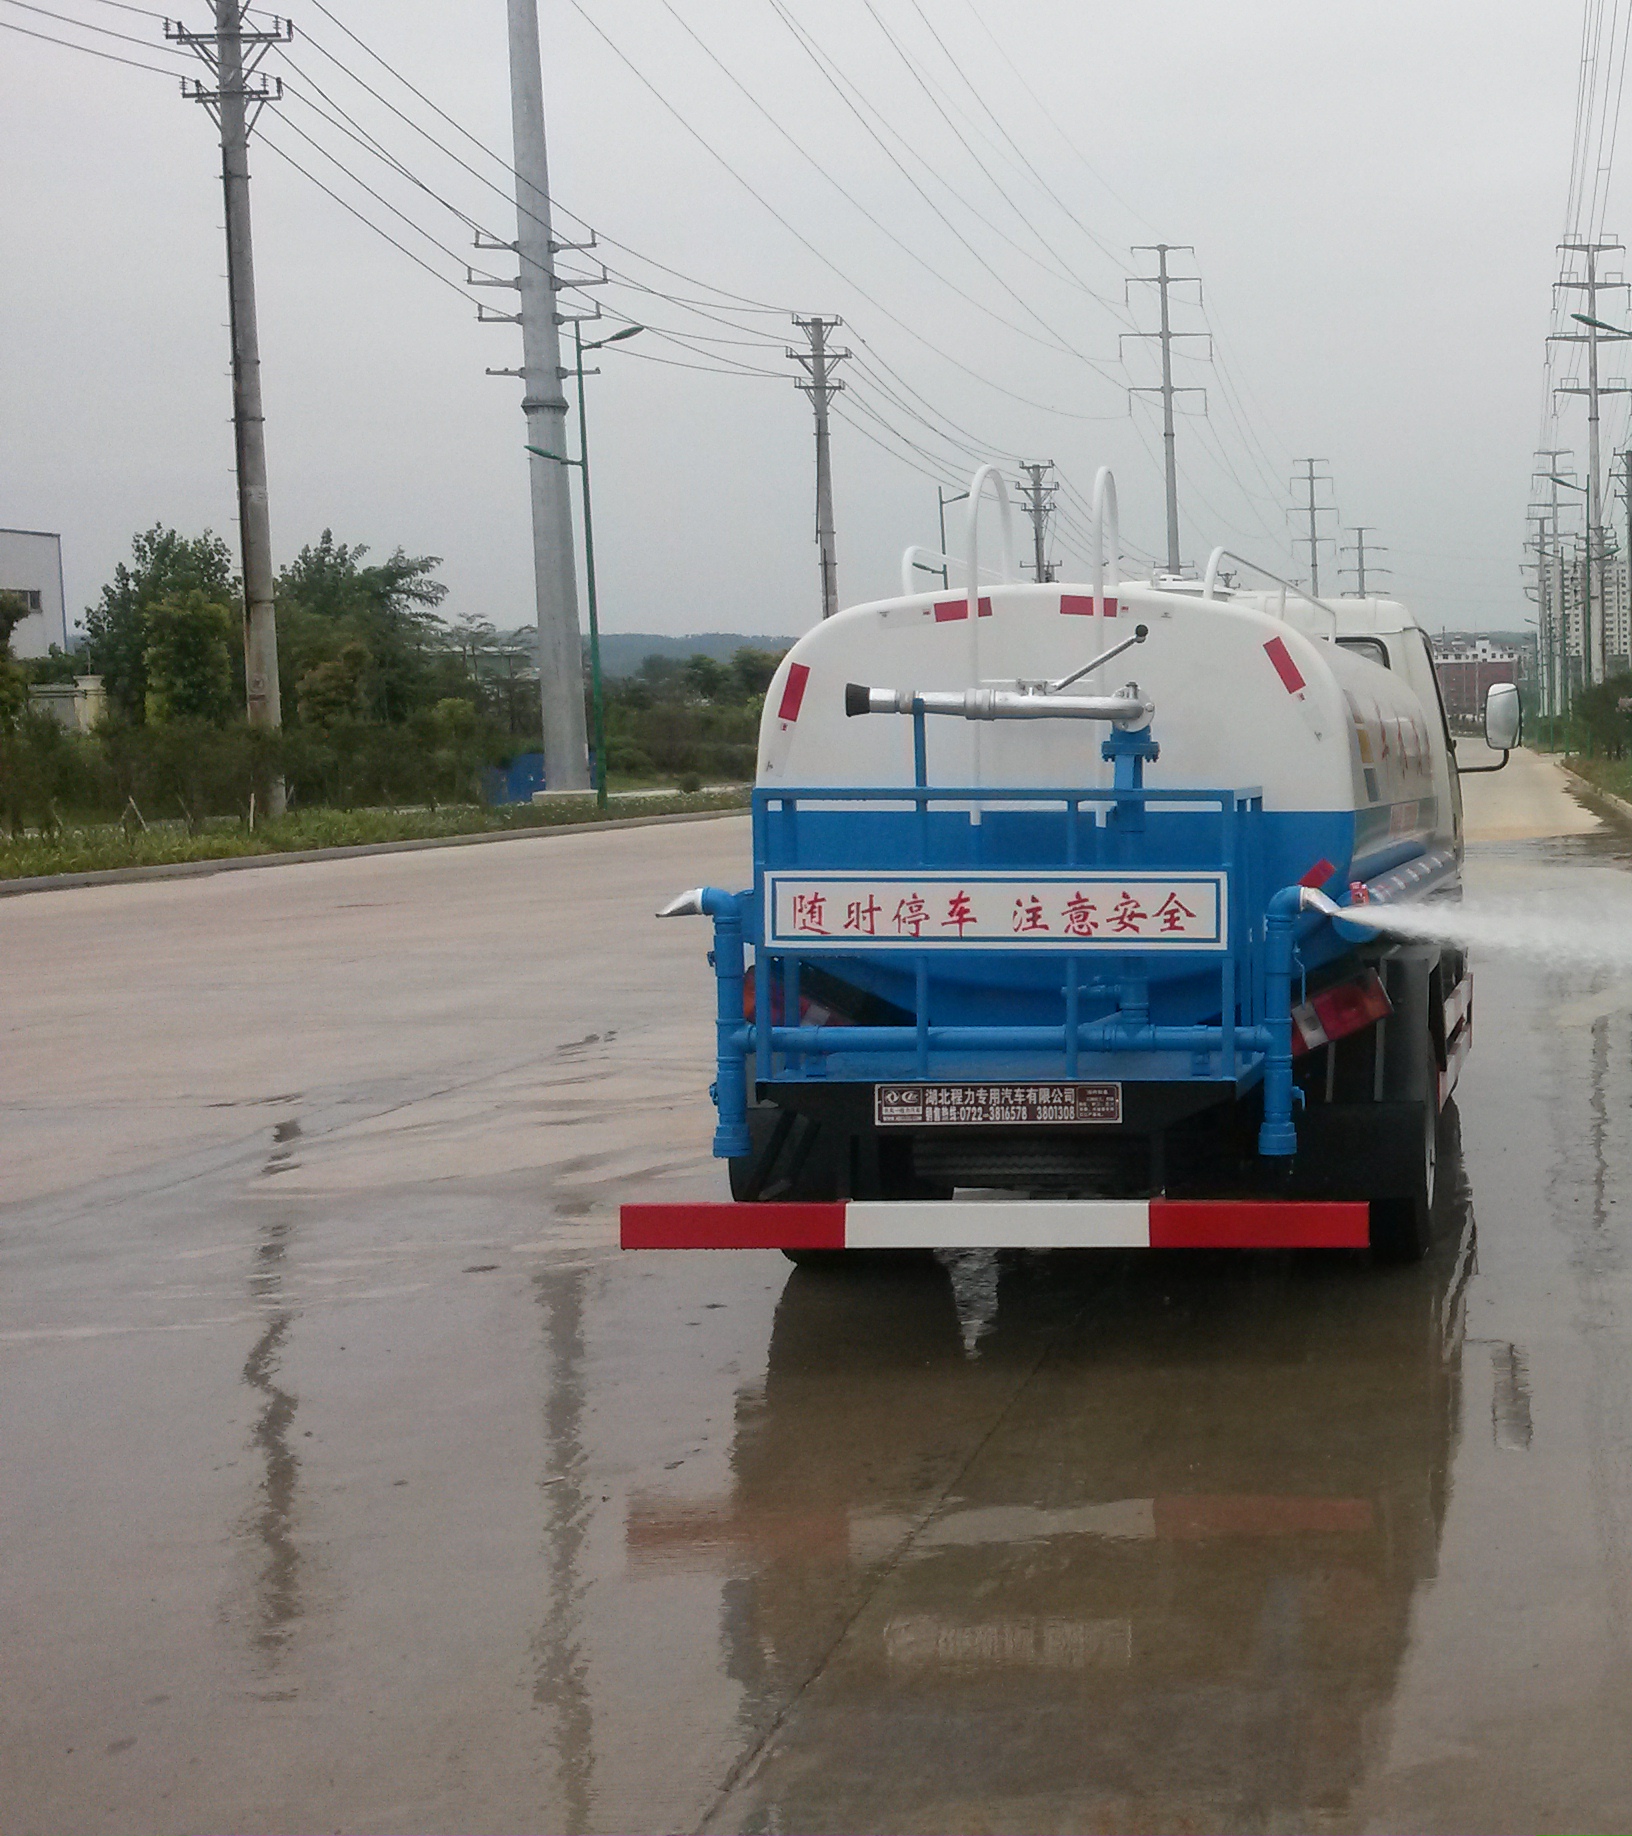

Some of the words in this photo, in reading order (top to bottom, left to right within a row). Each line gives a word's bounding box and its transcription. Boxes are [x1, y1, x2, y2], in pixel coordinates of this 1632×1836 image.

[792, 891, 978, 938] 随时停车
[1012, 891, 1197, 937] 注意安全
[925, 1088, 1075, 1105] 湖北程力专用汽车有限公司
[1036, 1106, 1075, 1120] 3801308
